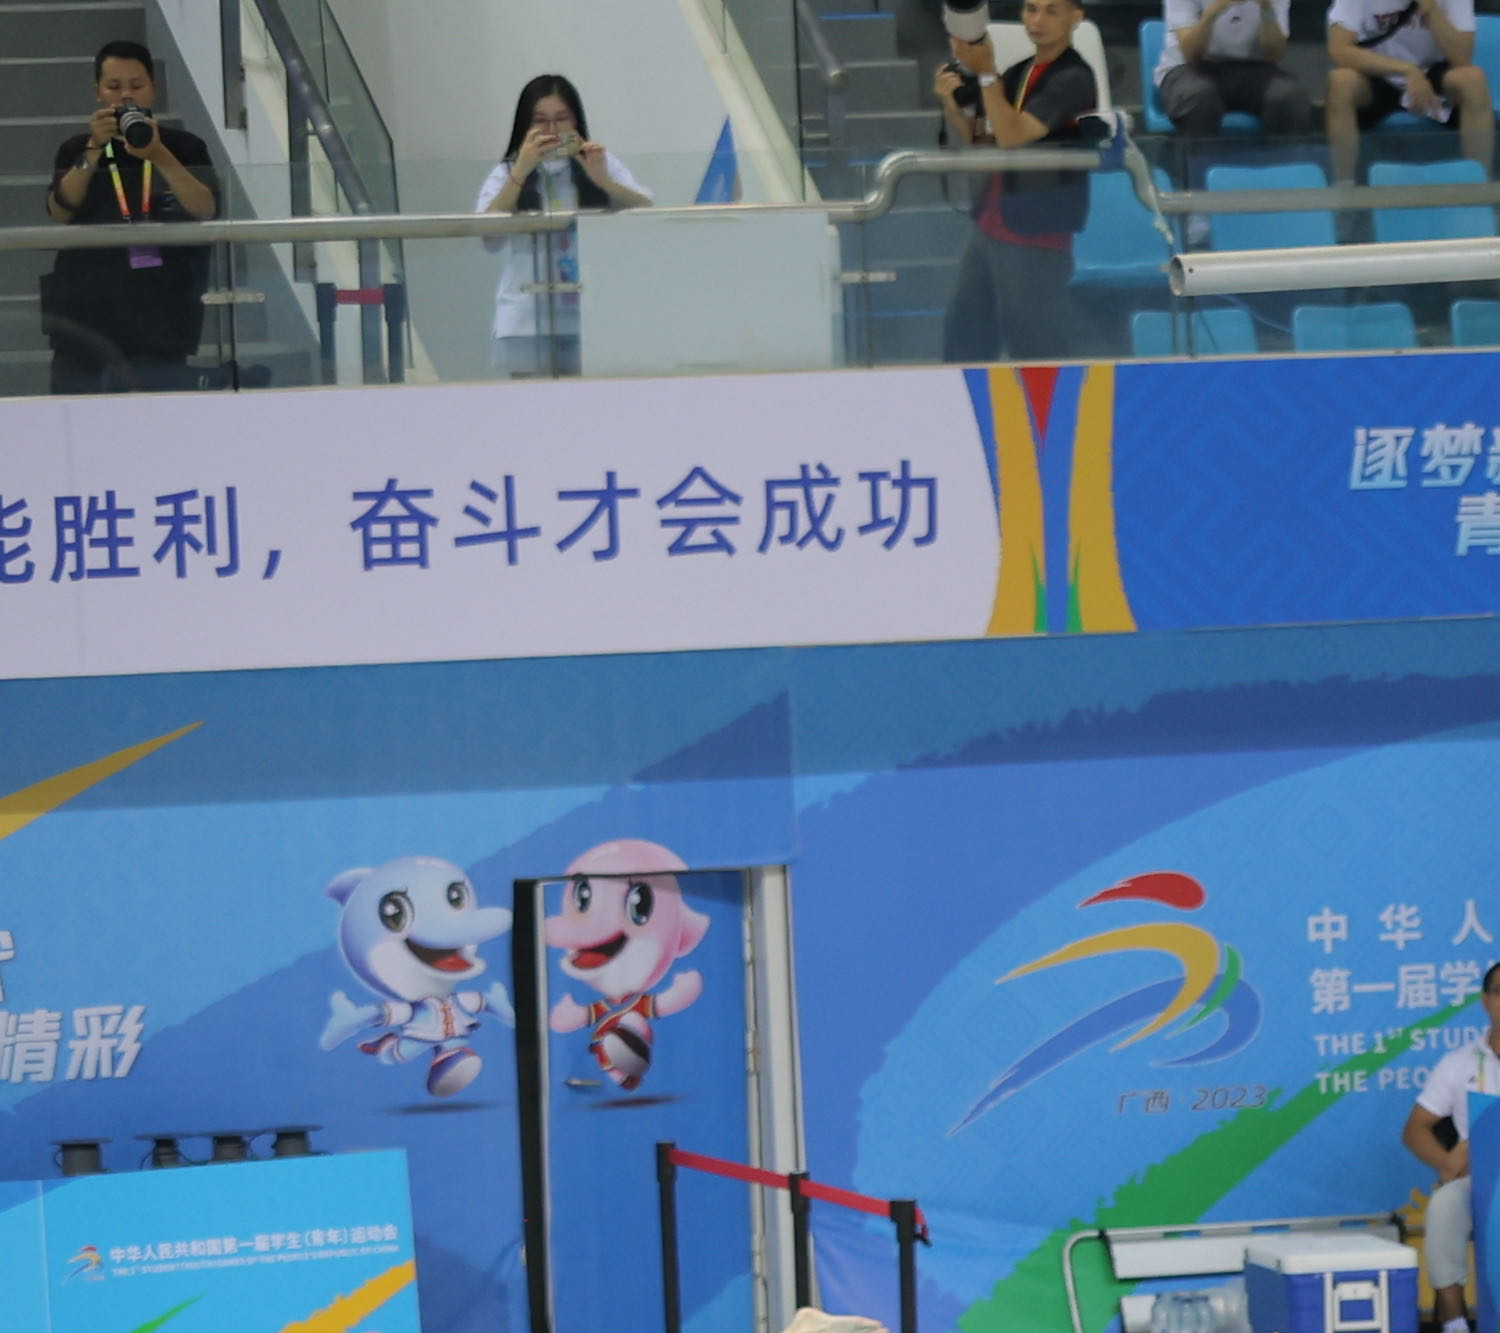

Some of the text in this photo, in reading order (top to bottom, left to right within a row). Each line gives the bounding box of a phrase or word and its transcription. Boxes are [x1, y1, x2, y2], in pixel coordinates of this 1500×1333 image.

[1314, 1033, 1366, 1057] THE
[1409, 1025, 1490, 1052] STUD
[1315, 1069, 1367, 1095] THE
